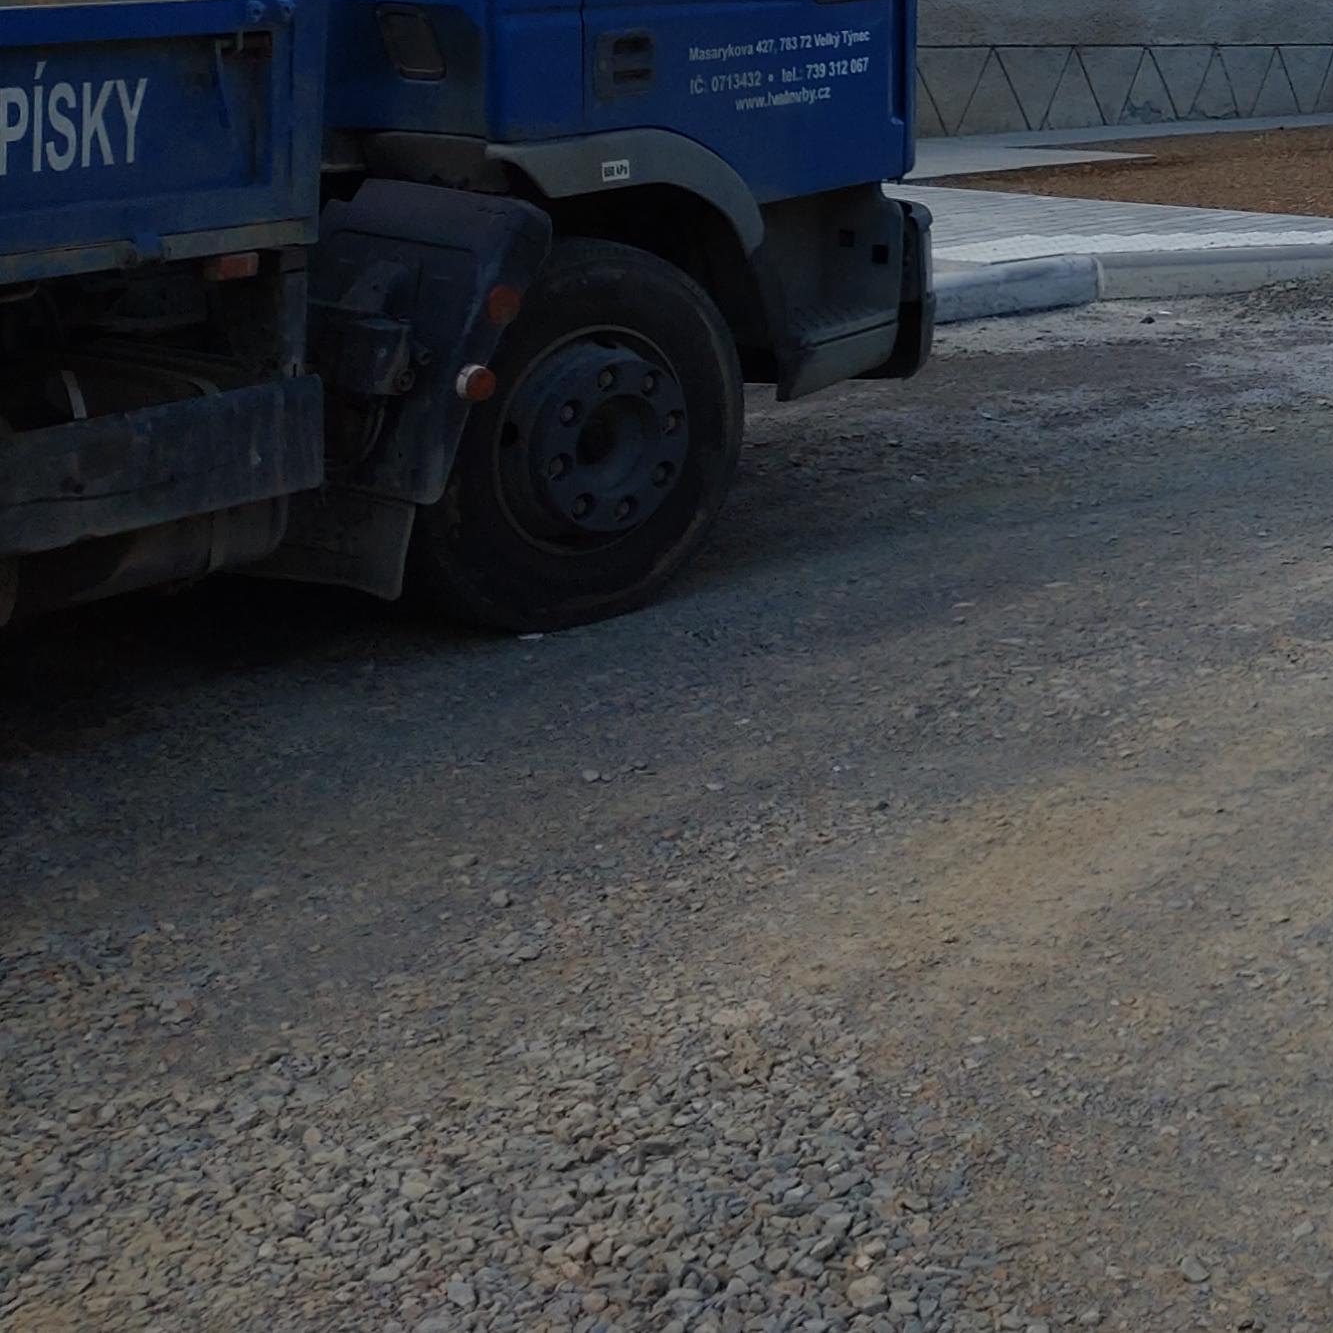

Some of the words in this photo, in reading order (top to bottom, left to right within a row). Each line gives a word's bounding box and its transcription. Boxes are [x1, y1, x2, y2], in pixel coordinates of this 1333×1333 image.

[688, 43, 755, 62] Masarykova
[756, 38, 777, 55] 427,
[779, 36, 798, 52] 783
[799, 34, 813, 49] 72
[841, 29, 871, 47] Týnec
[711, 70, 762, 92] 0713432
[805, 62, 826, 79] 739
[828, 59, 849, 77] 312
[850, 56, 870, 74] 067
[0, 60, 148, 176] PÍSKY
